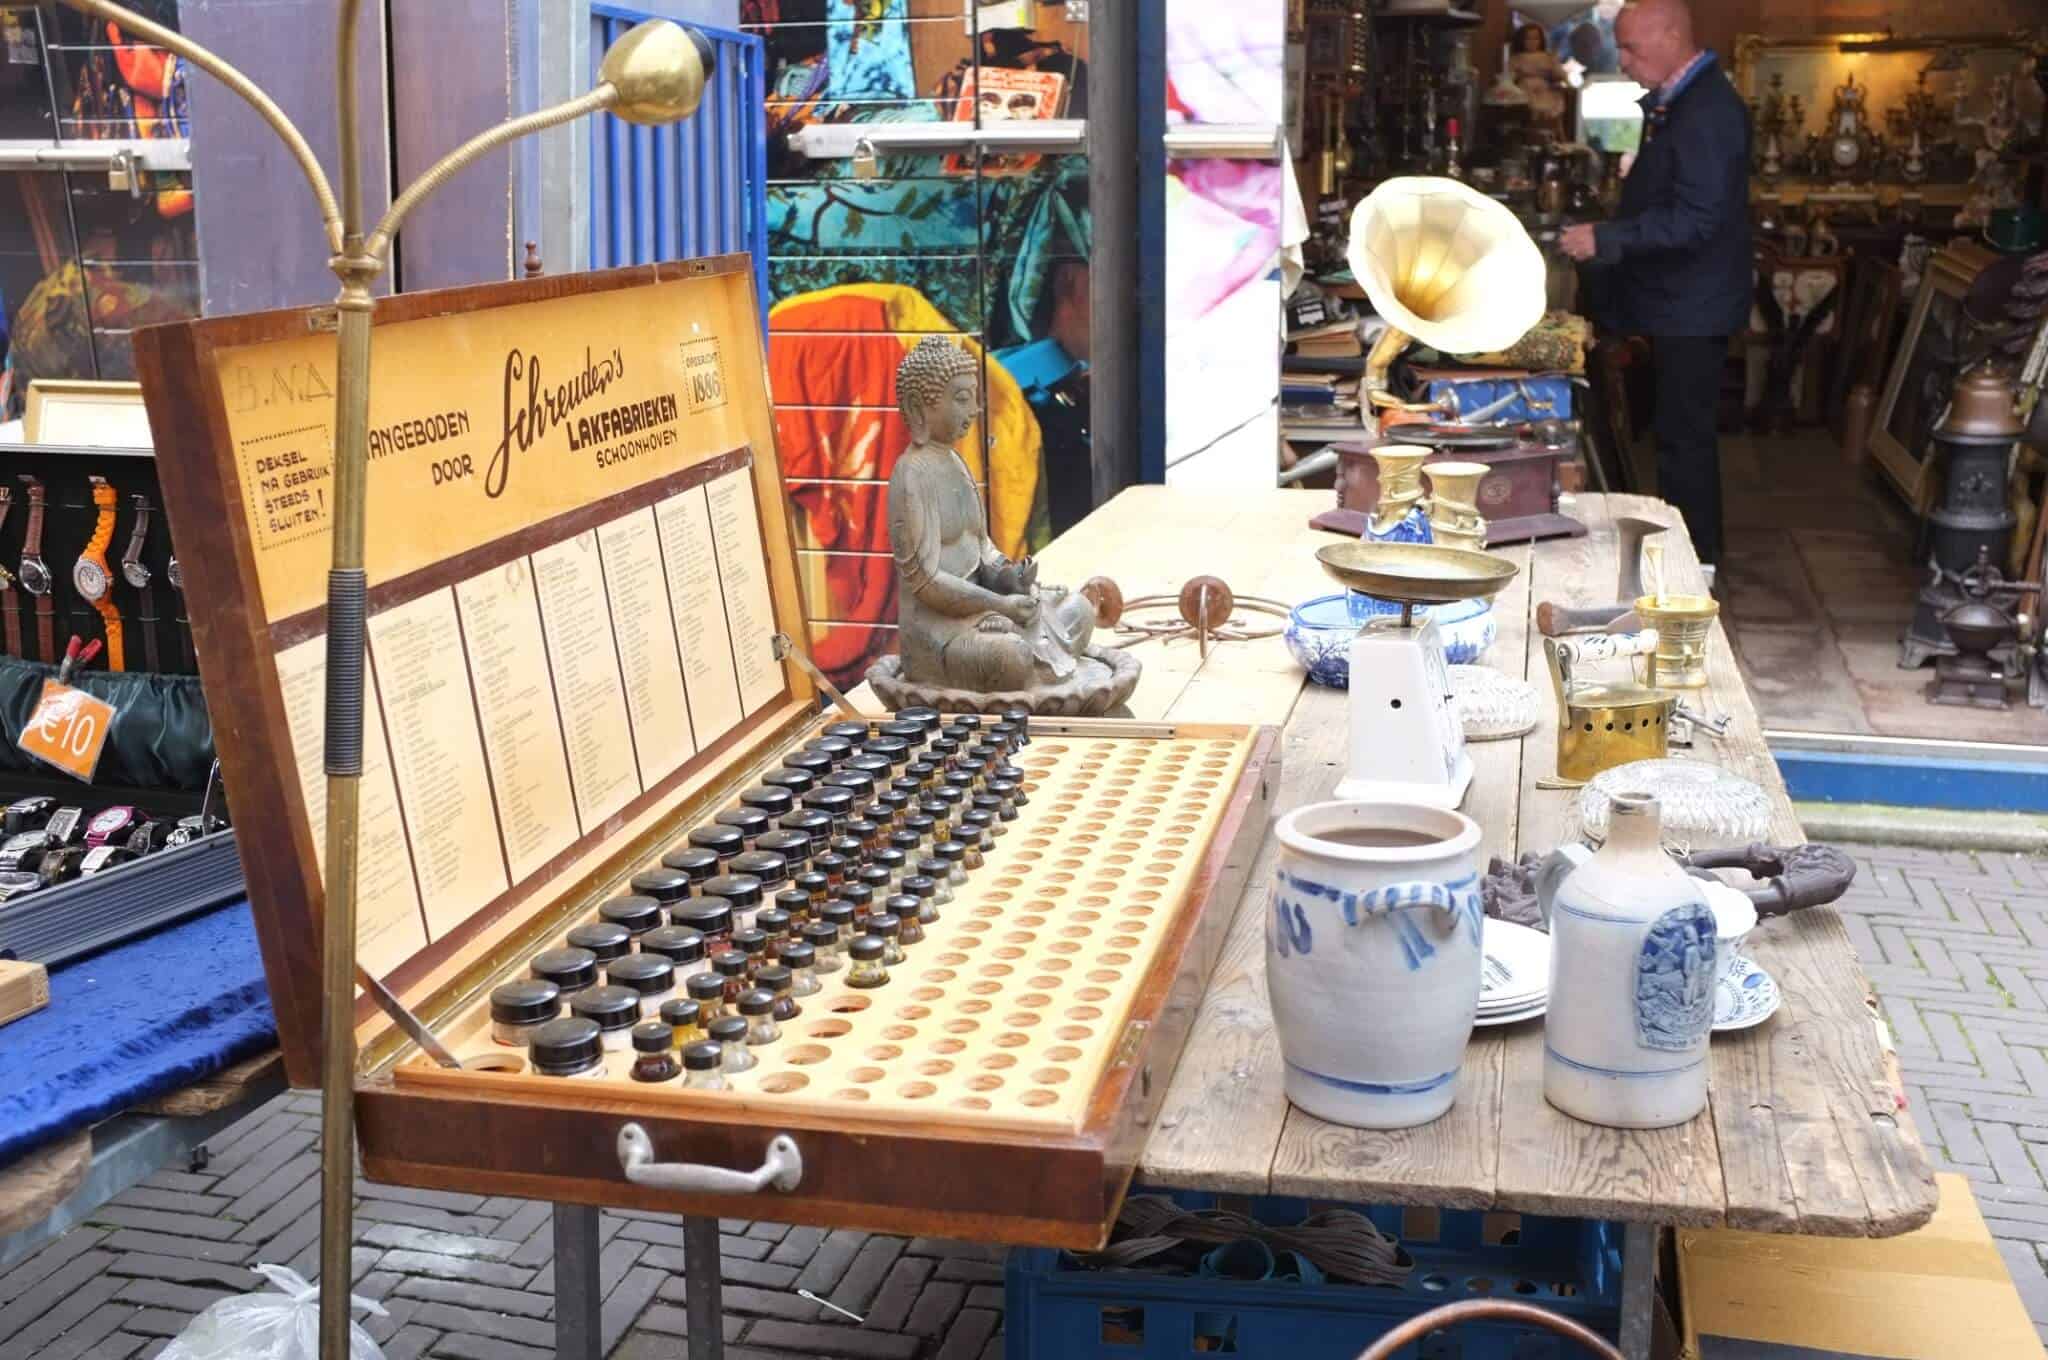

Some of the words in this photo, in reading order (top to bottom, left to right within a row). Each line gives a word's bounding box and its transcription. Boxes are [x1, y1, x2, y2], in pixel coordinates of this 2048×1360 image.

[692, 370, 721, 404] 1886
[367, 410, 470, 460] ANGEBODEN
[485, 346, 624, 498] Schreuder's
[566, 393, 678, 452] LAKFABRIEKEN
[256, 451, 308, 474] DEKSEL
[596, 429, 678, 469] SCHOONHOVEN
[261, 479, 280, 494] NA
[283, 465, 330, 489] GEBRUIK
[431, 453, 474, 486] DOOR
[264, 489, 311, 514] STEEDS
